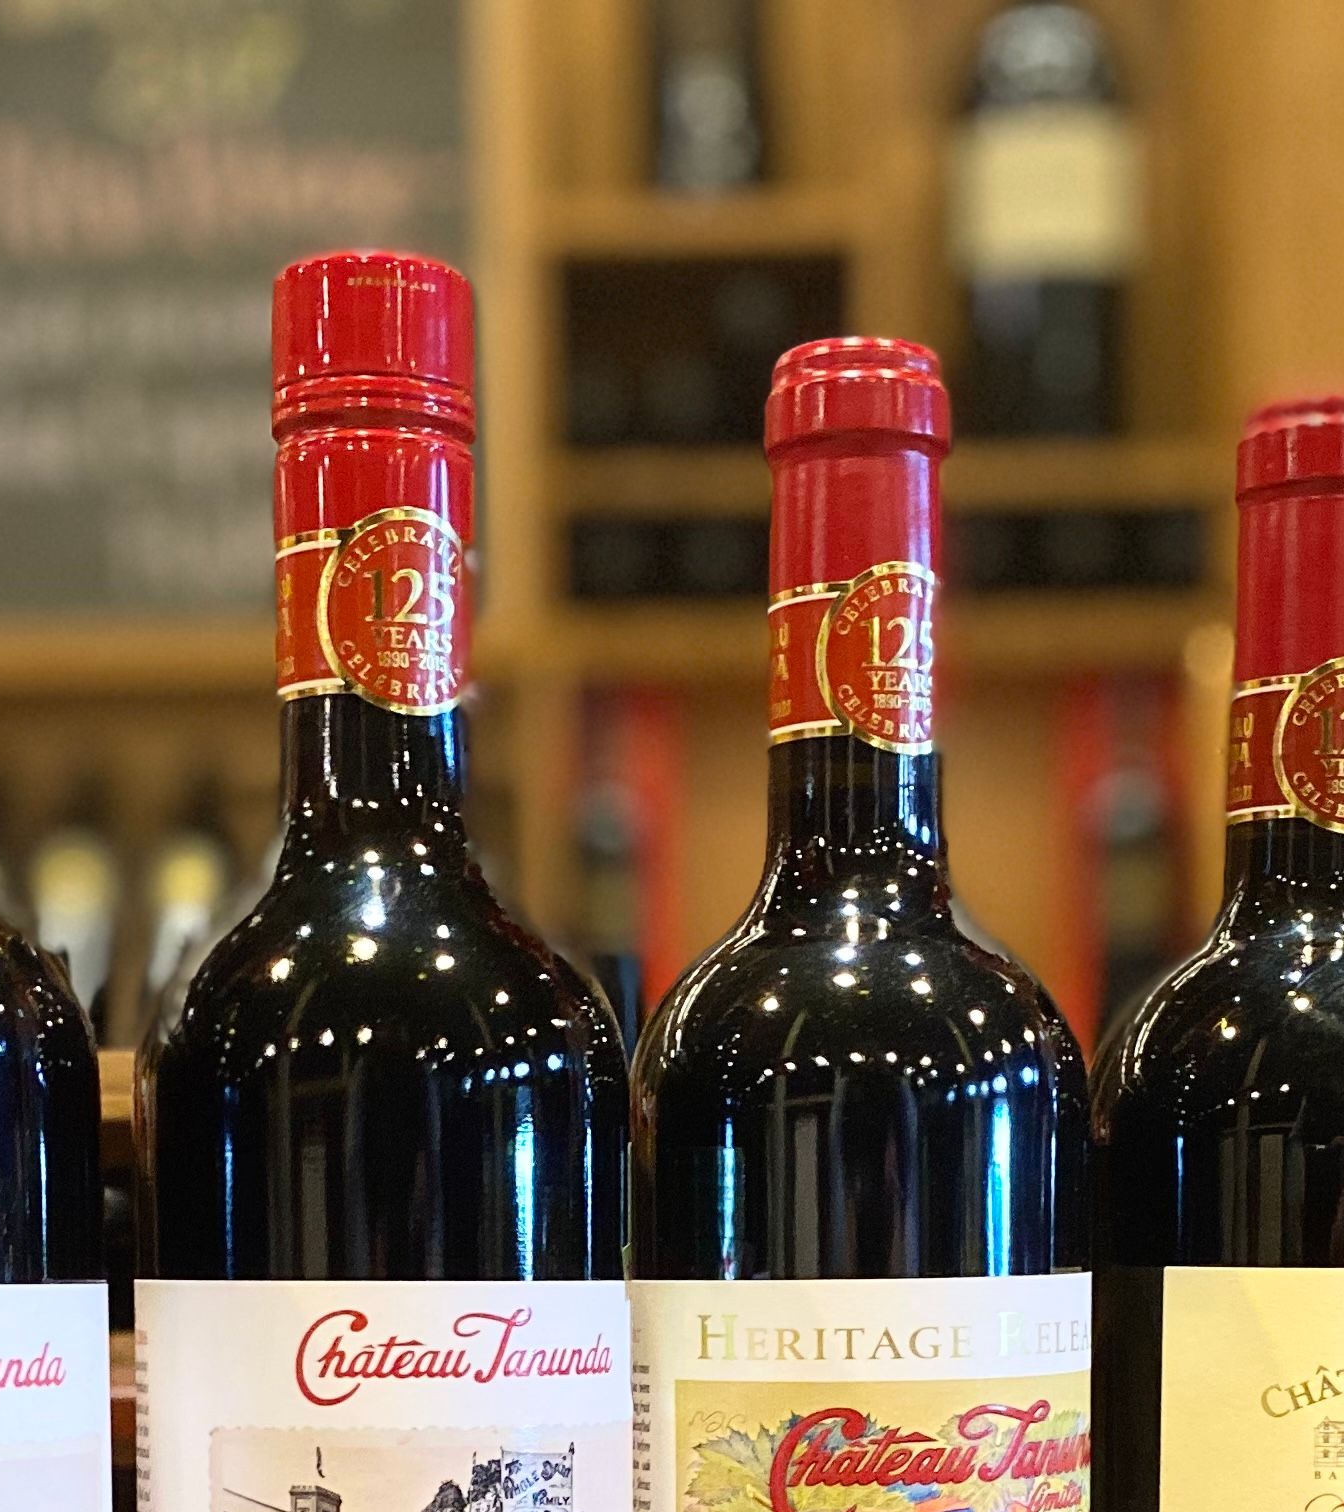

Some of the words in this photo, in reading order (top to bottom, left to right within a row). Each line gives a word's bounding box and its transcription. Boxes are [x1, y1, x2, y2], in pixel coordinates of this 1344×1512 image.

[362, 567, 456, 627] 125
[371, 625, 453, 655] YEARS
[295, 1308, 472, 1407] Château
[453, 1306, 613, 1383] Tanunda
[697, 1314, 973, 1363] HERITAGE
